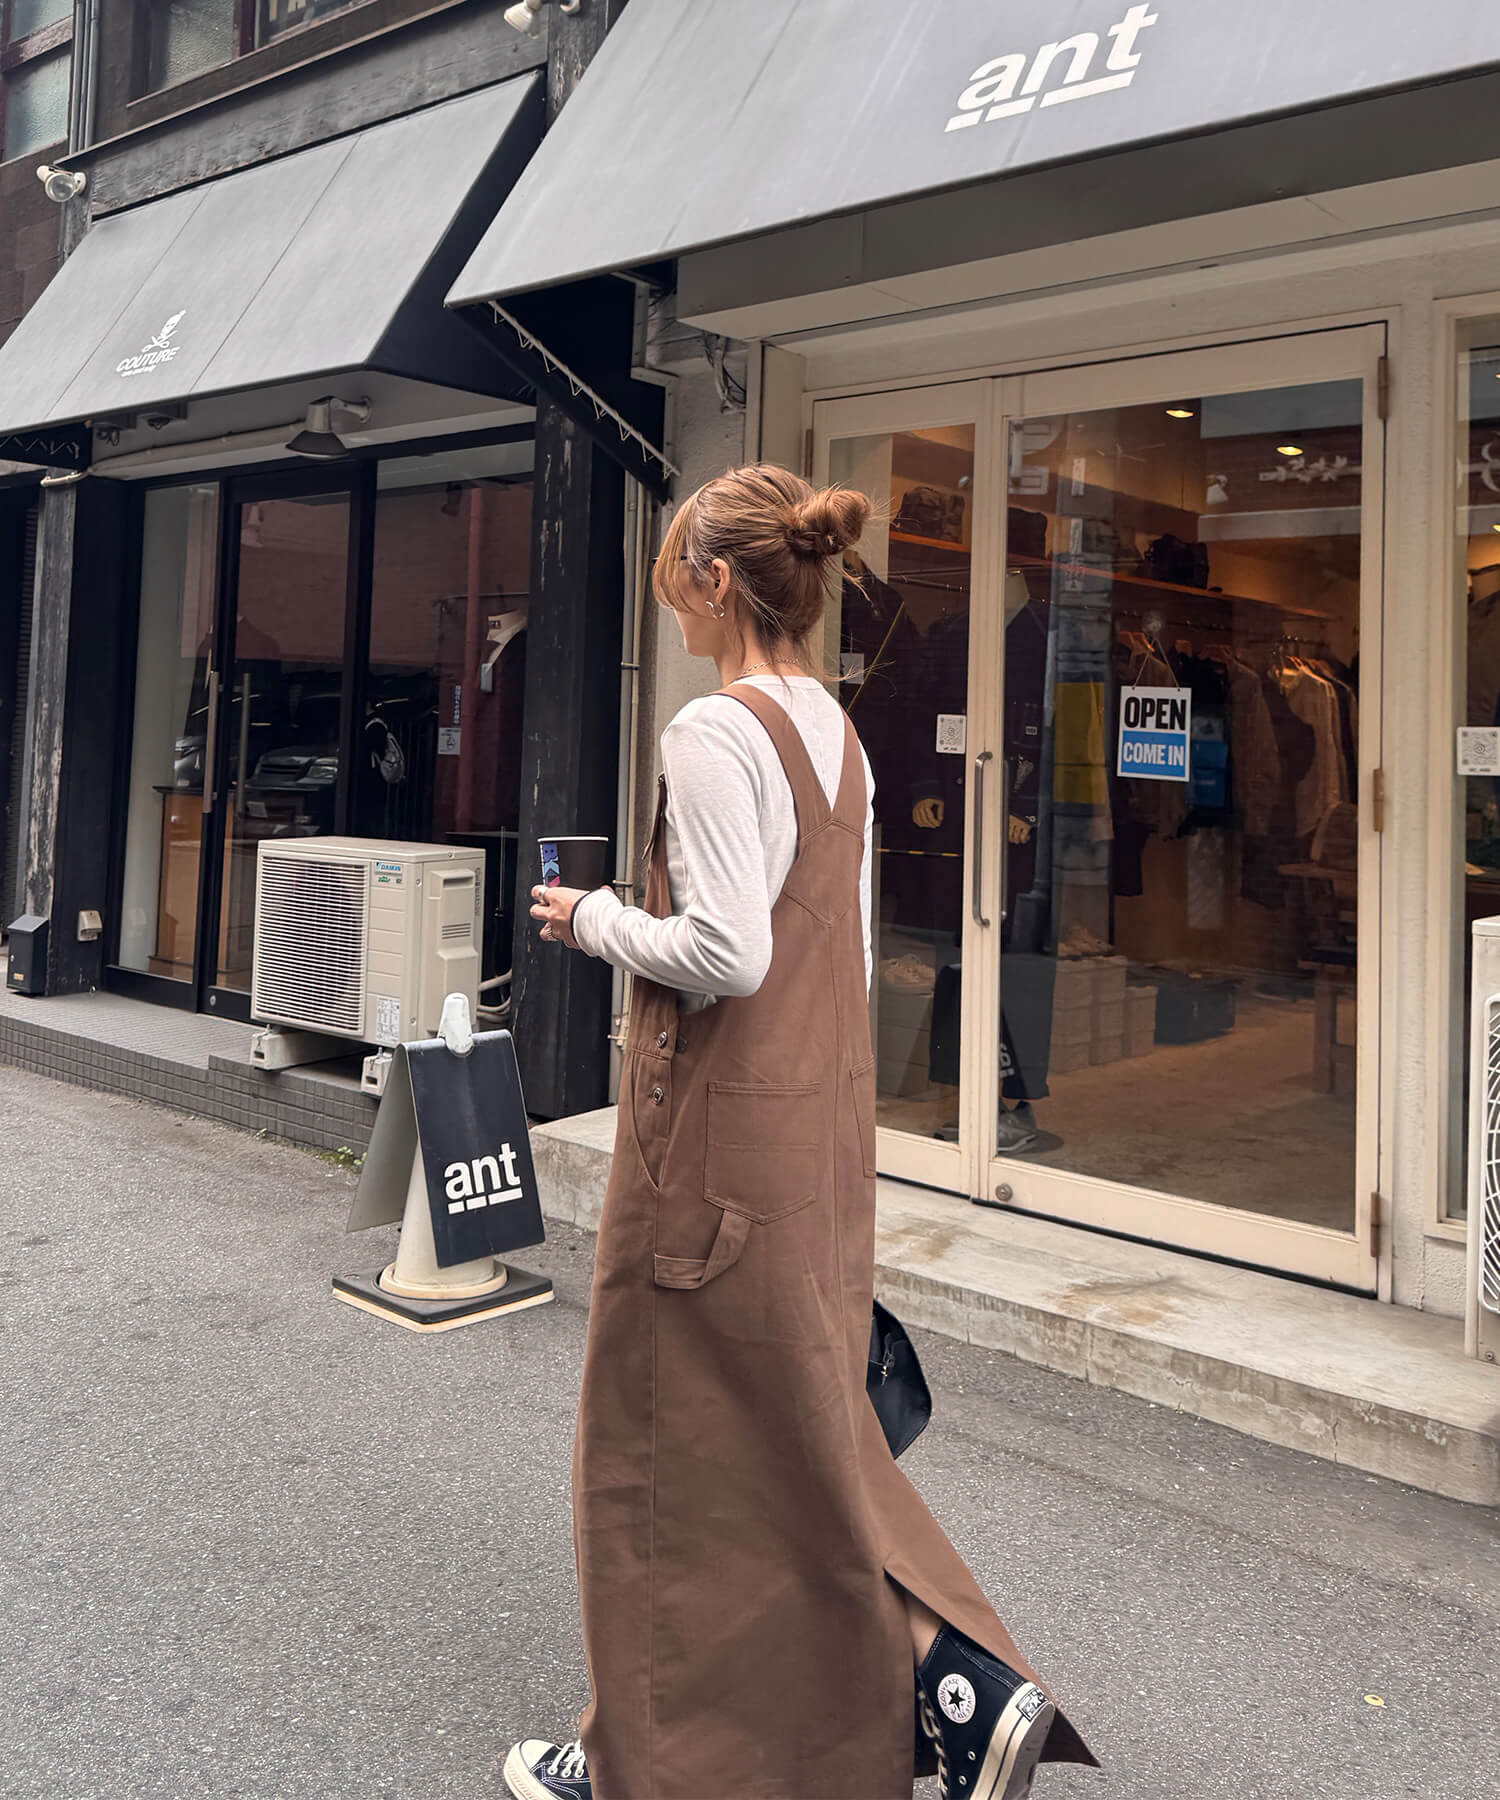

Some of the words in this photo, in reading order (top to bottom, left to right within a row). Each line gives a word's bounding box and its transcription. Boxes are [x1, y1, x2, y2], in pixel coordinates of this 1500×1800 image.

[956, 2, 1159, 112] ant
[116, 346, 181, 372] COUTURE
[1124, 696, 1187, 731] OPEN
[1123, 741, 1166, 765] COME
[1167, 744, 1184, 767] IN
[444, 1142, 521, 1200] ant
